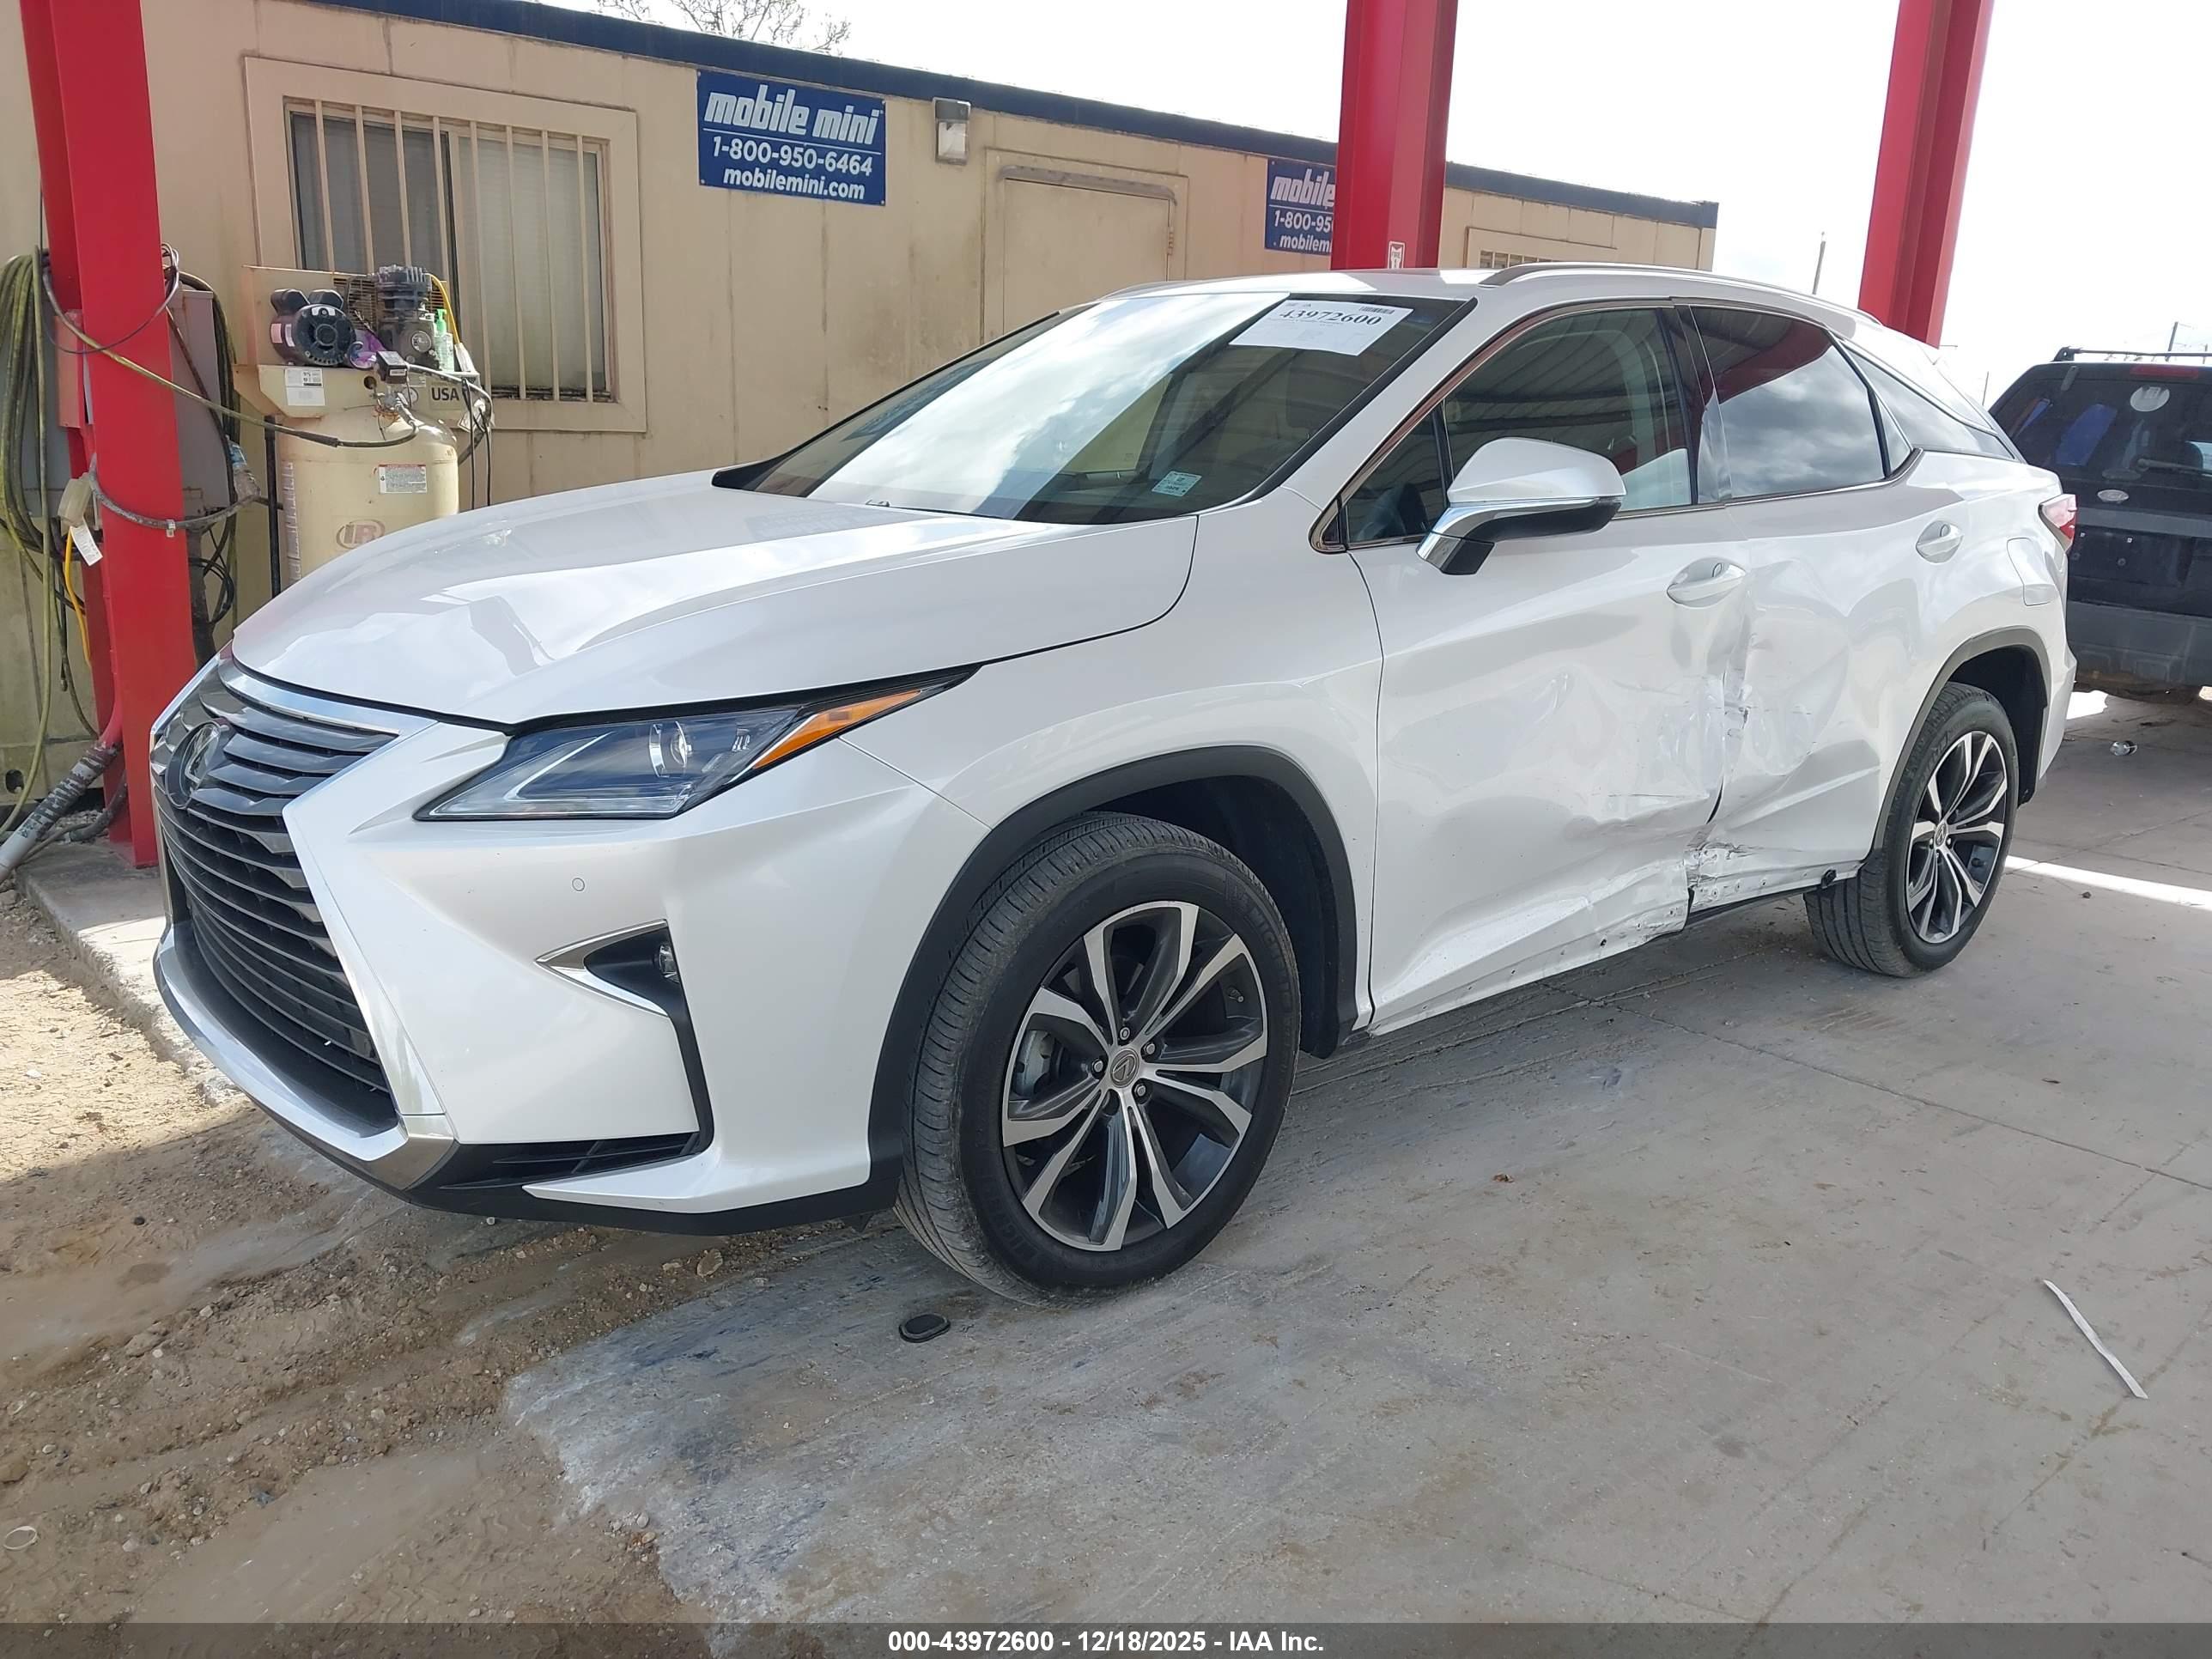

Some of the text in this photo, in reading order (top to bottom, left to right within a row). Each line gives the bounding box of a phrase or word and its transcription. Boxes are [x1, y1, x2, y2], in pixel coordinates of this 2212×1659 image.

[703, 84, 880, 145] mobile mini
[713, 136, 872, 177] 1-800-950-6464
[723, 167, 866, 200] mobilemini.com
[1270, 168, 1336, 208] mobile
[1274, 210, 1334, 233] 1-800-95
[431, 387, 459, 401] USA
